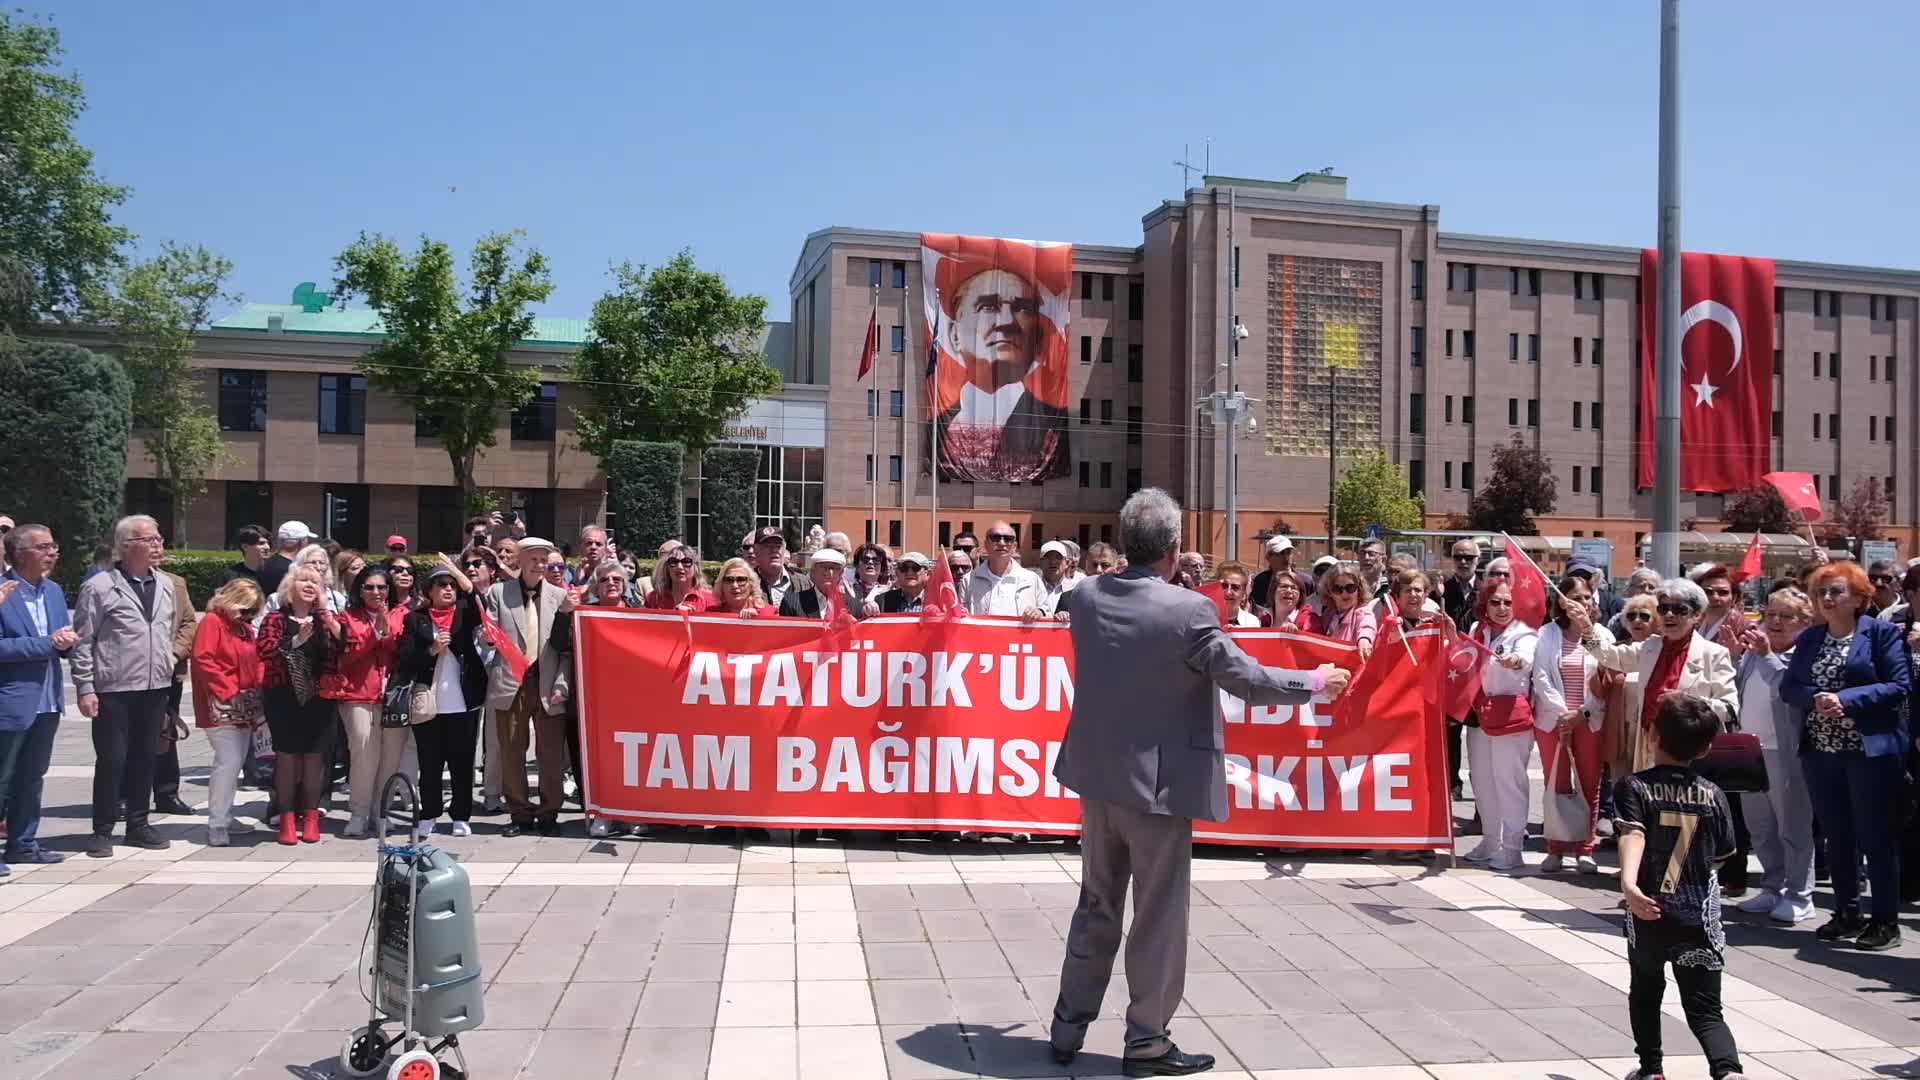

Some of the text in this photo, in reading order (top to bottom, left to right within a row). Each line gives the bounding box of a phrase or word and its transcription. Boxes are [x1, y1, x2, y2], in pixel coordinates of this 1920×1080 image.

[614, 721, 1413, 811] TAM BAĞIMSI RKİYE
[1659, 811, 1699, 894] 7
